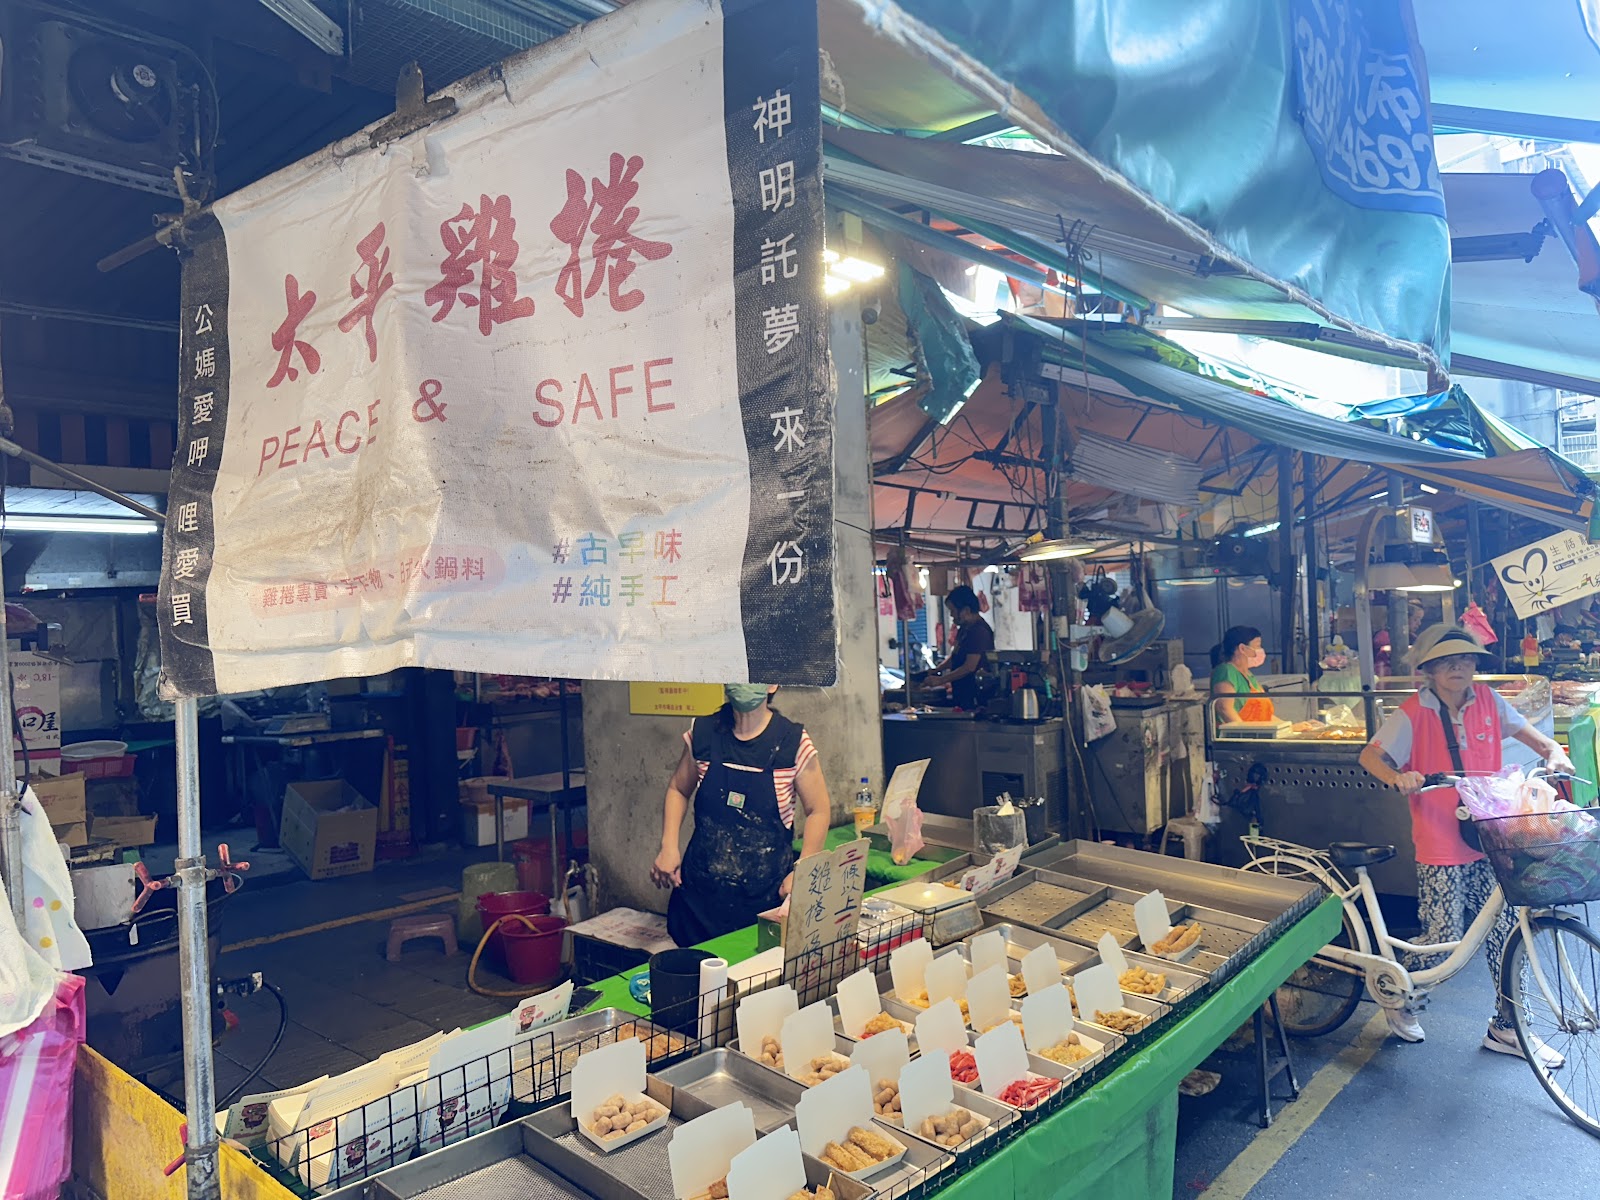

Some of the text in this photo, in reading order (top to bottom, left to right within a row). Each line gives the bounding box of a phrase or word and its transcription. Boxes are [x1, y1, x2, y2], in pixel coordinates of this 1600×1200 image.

[266, 152, 673, 388] 太平雞捲
[753, 89, 806, 586] 神明託夢 來一份
[171, 303, 215, 626] 公媽愛呷 哩愛買
[258, 357, 676, 477] PEACE & SAFE
[552, 528, 683, 565] #古早味
[552, 574, 679, 607] #純手工
